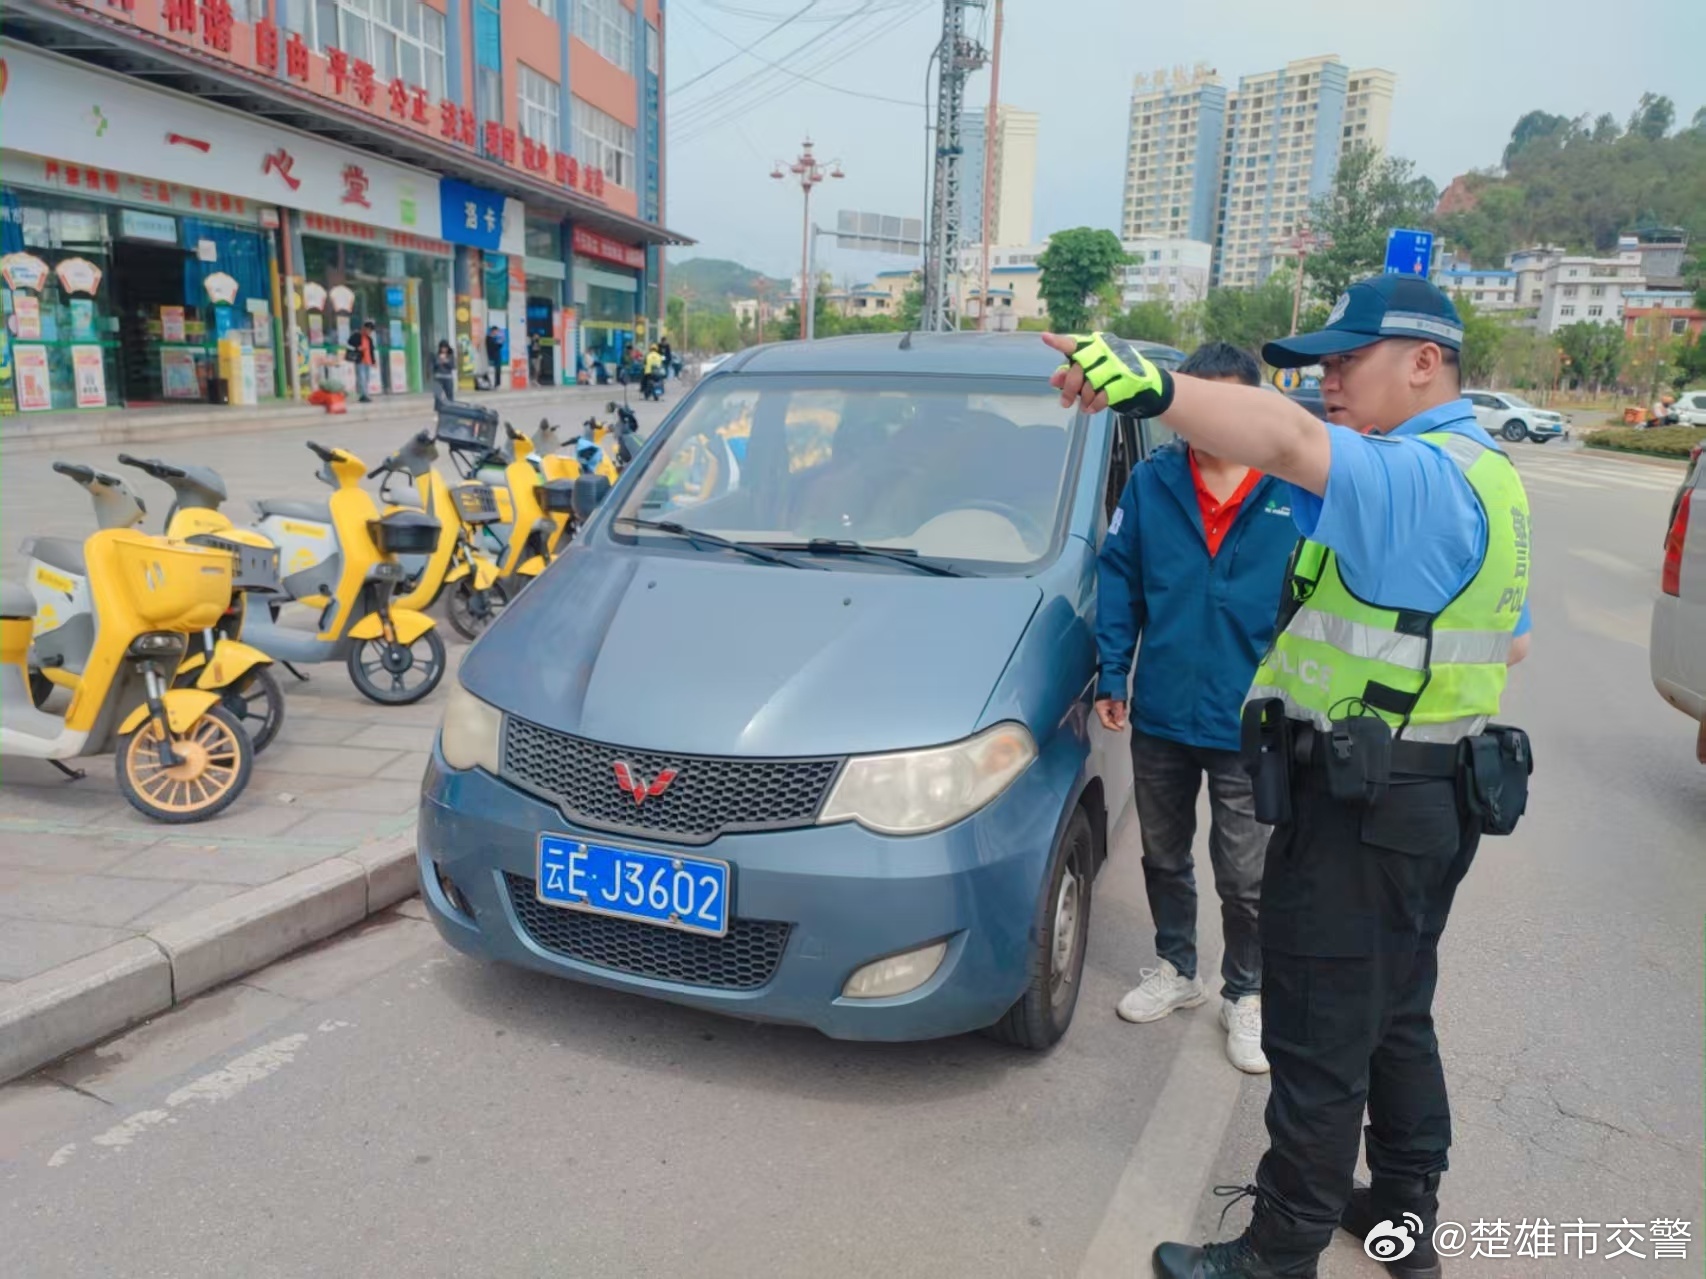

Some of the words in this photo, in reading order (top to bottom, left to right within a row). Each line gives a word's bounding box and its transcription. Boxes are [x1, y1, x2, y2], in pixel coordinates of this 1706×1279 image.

[256, 17, 309, 82] 自由
[326, 45, 375, 106] 平等
[388, 77, 430, 125] 公正
[165, 132, 372, 208] 一心堂
[546, 847, 719, 922] 云E·J3602
